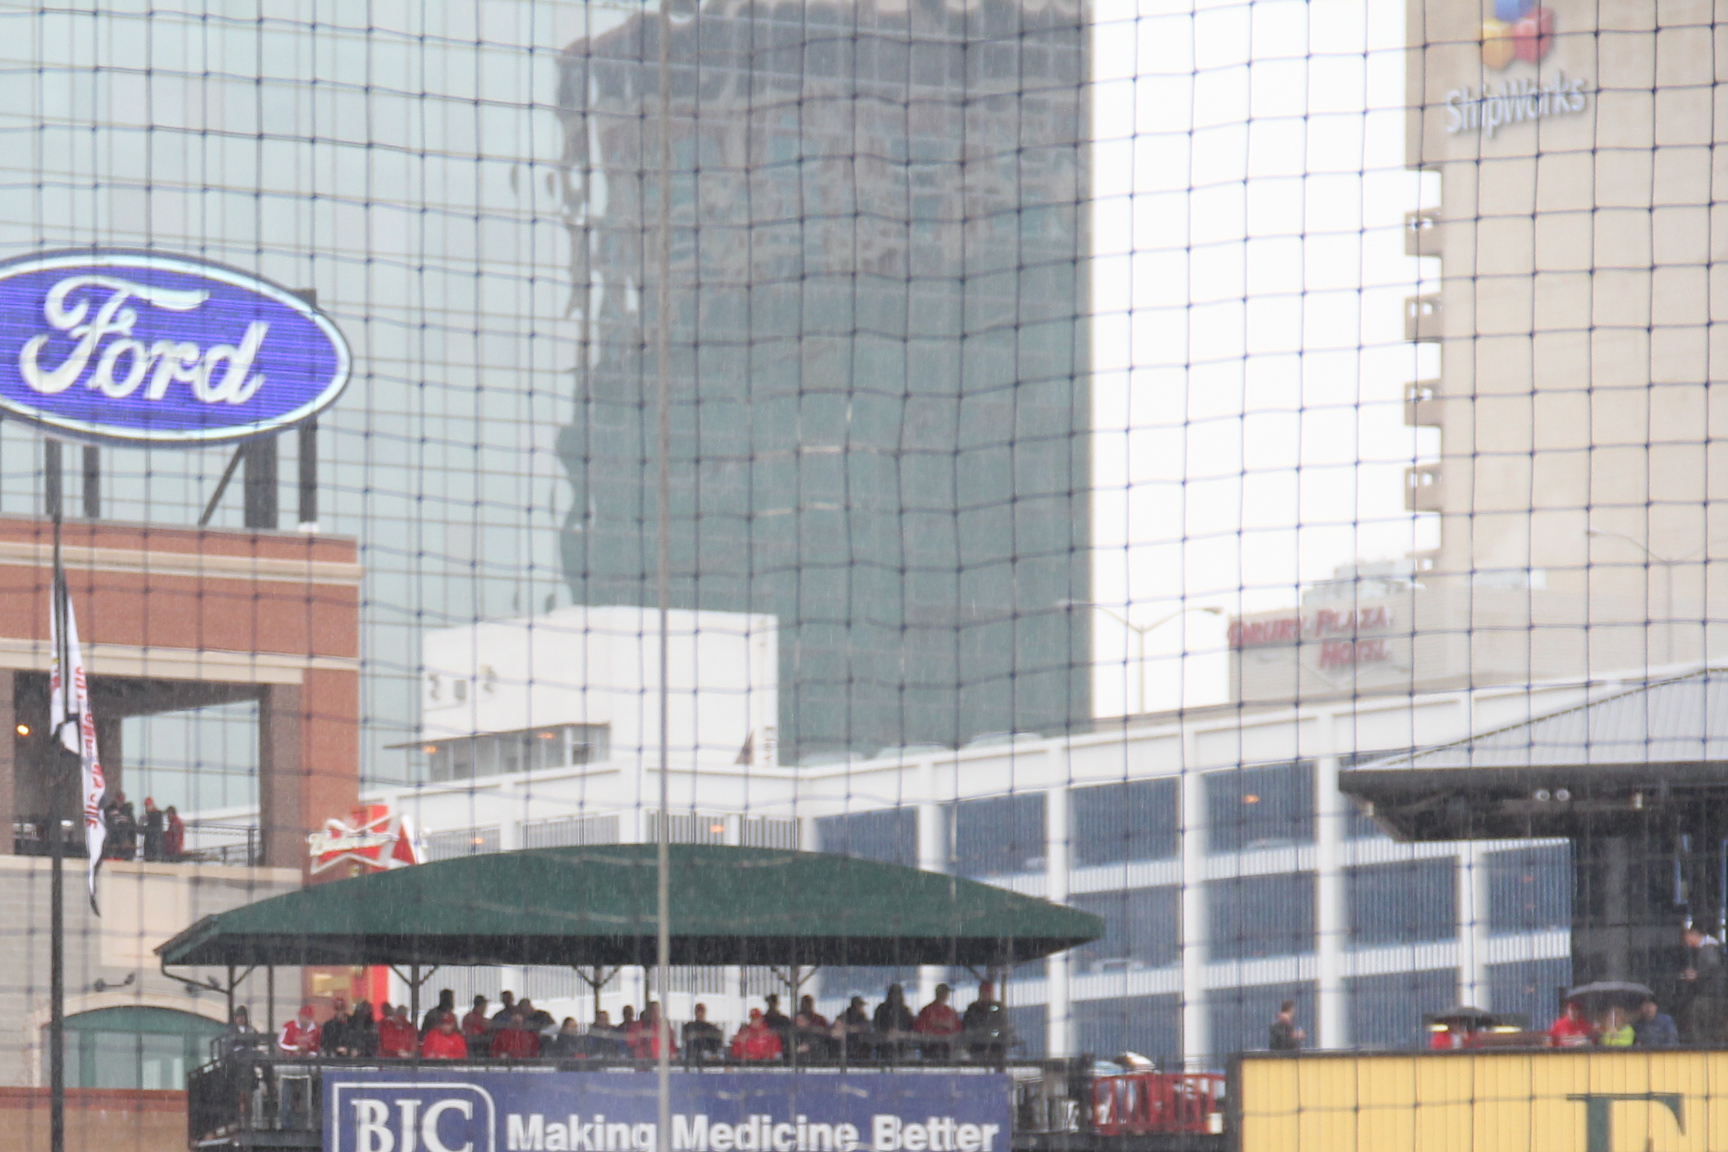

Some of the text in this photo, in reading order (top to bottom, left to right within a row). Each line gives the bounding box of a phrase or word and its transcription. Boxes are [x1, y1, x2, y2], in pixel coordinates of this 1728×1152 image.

[1445, 69, 1586, 138] ShipWorks
[19, 275, 270, 405] Ford
[672, 1113, 858, 1152] Medicine
[873, 1113, 999, 1152] Better
